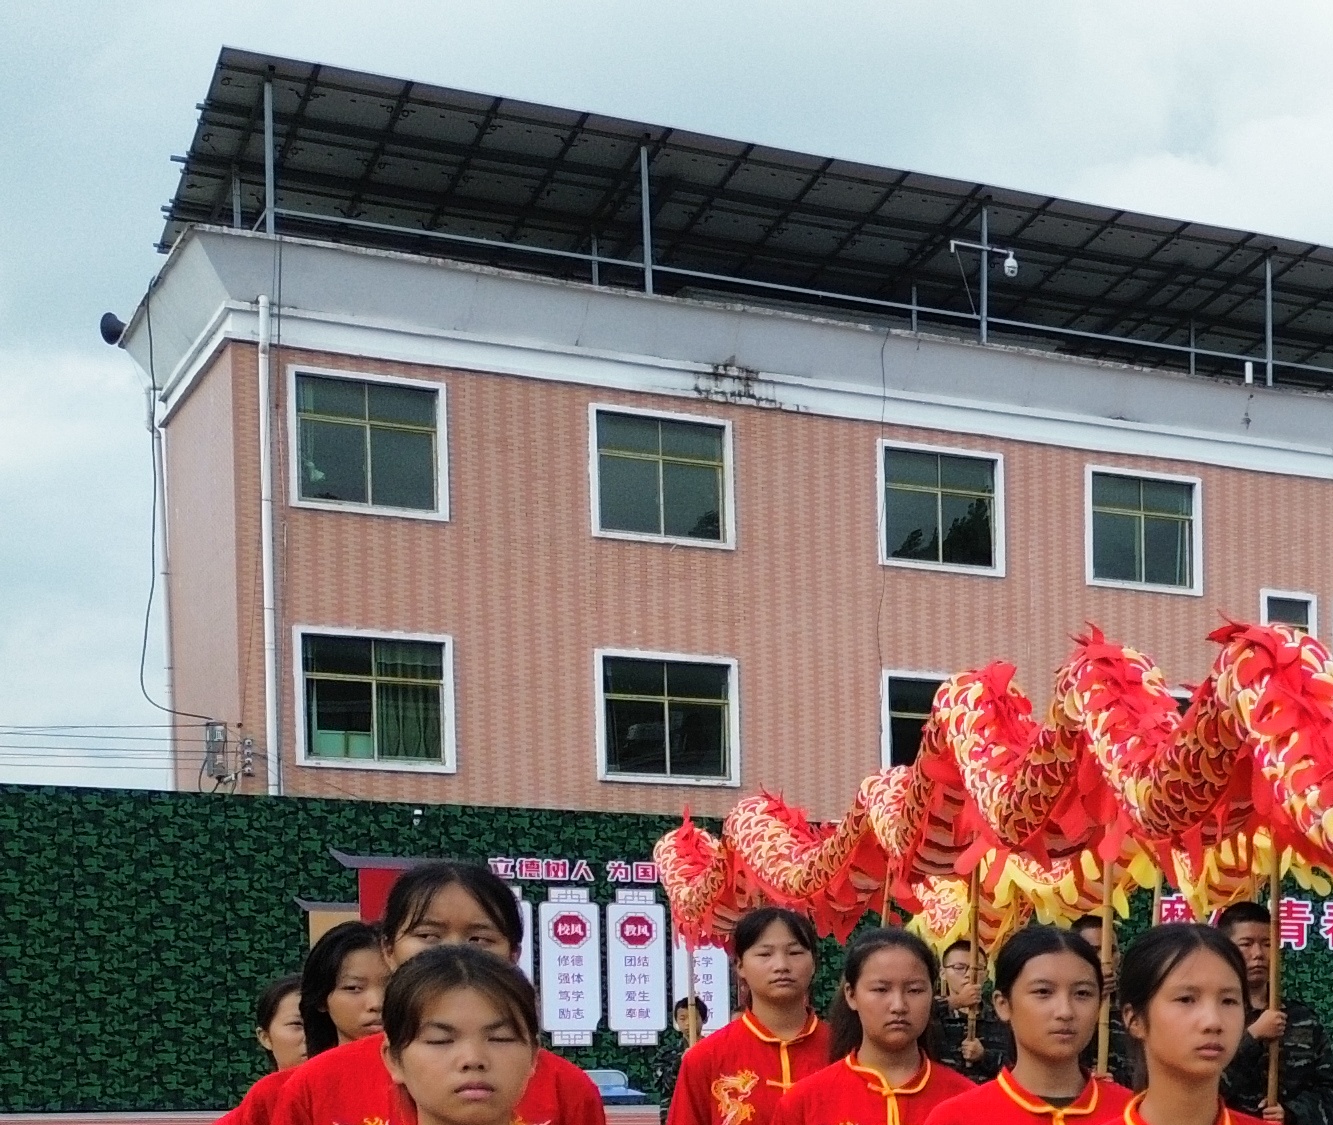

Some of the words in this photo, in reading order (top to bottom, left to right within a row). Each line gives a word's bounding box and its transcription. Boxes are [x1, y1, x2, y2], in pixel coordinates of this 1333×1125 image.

[488, 857, 595, 882] 立德树人
[557, 922, 584, 936] 校风
[624, 924, 650, 937] 教风
[557, 954, 584, 967] 修德
[624, 955, 649, 967] 团结
[558, 972, 584, 984] 强体
[624, 973, 650, 985] 协作
[558, 990, 585, 1002] 笃学
[625, 990, 650, 1002] 爱生
[558, 1007, 585, 1020] 励志
[625, 1007, 650, 1019] 奉献
